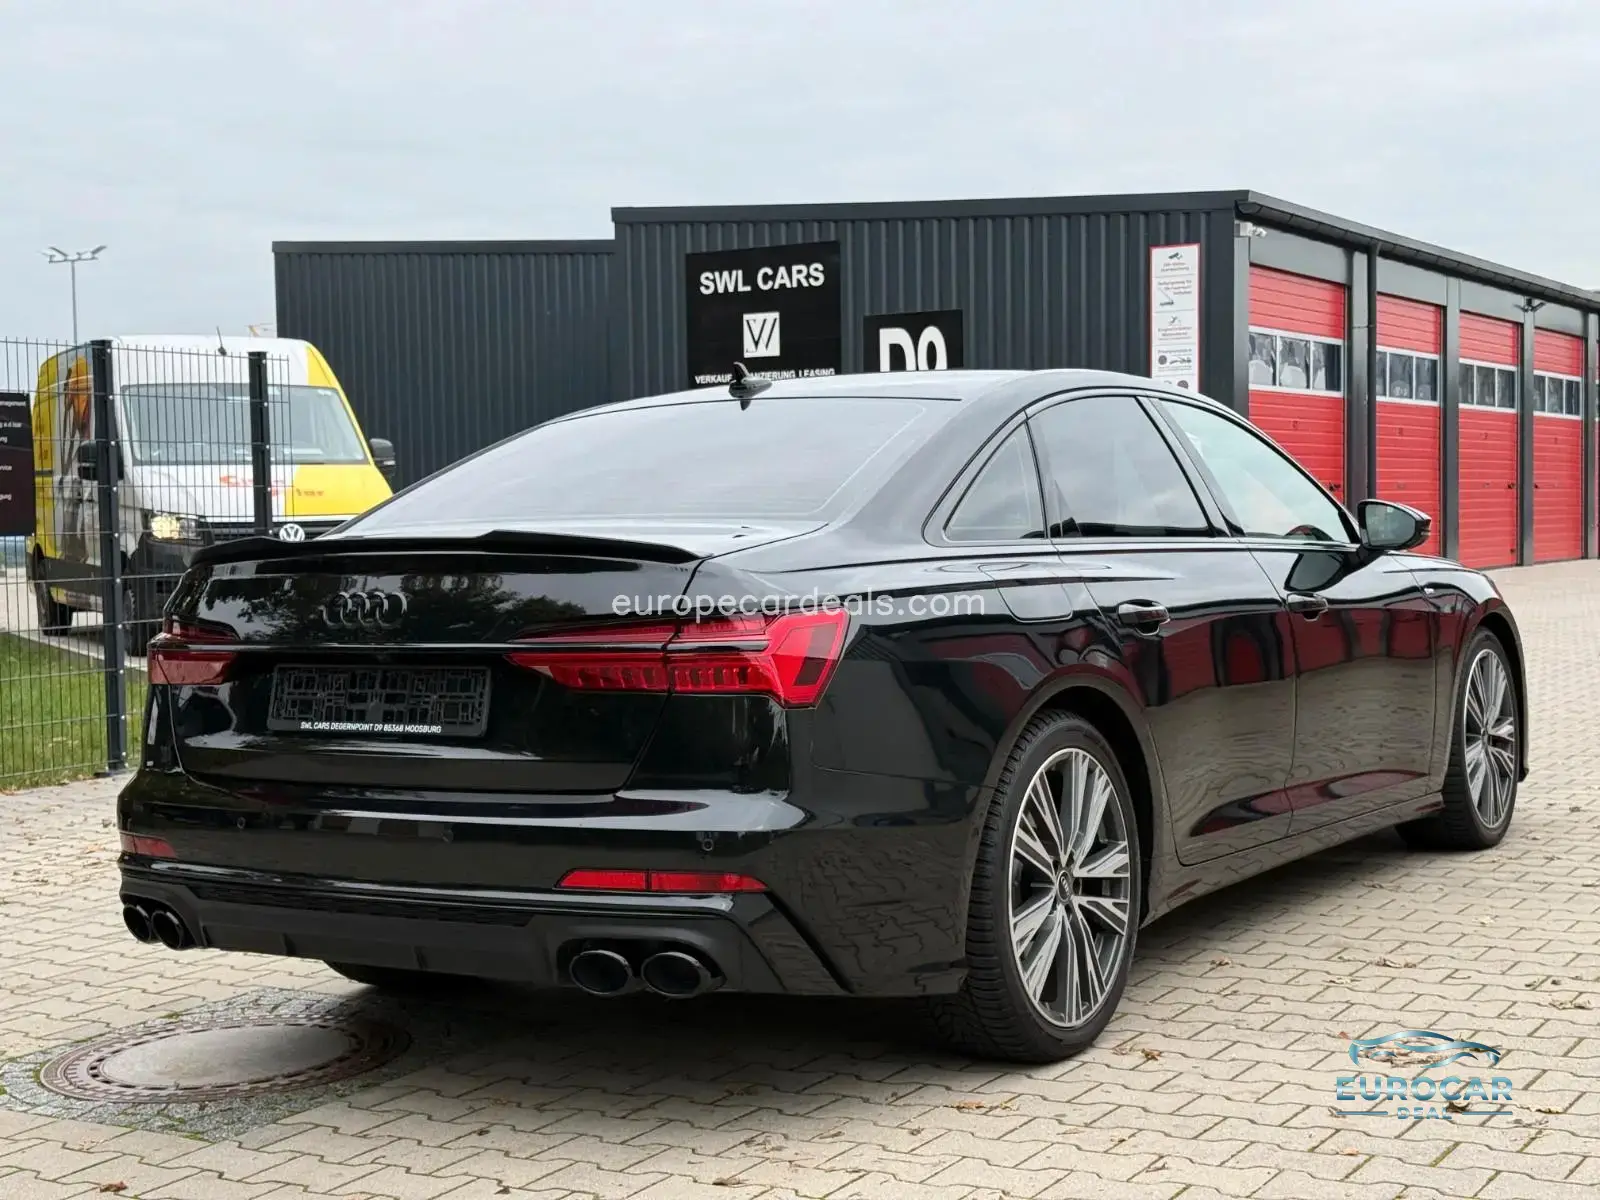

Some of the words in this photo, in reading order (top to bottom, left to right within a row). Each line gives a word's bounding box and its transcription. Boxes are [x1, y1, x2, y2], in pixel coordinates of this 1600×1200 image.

[699, 269, 752, 295] SWL
[756, 262, 825, 291] CARS
[694, 374, 733, 384] VERKAUF
[300, 721, 313, 729] SWL
[313, 721, 330, 730] CARS
[330, 722, 374, 731] DEGERNPOINT
[404, 724, 442, 733] MOOSBURG
